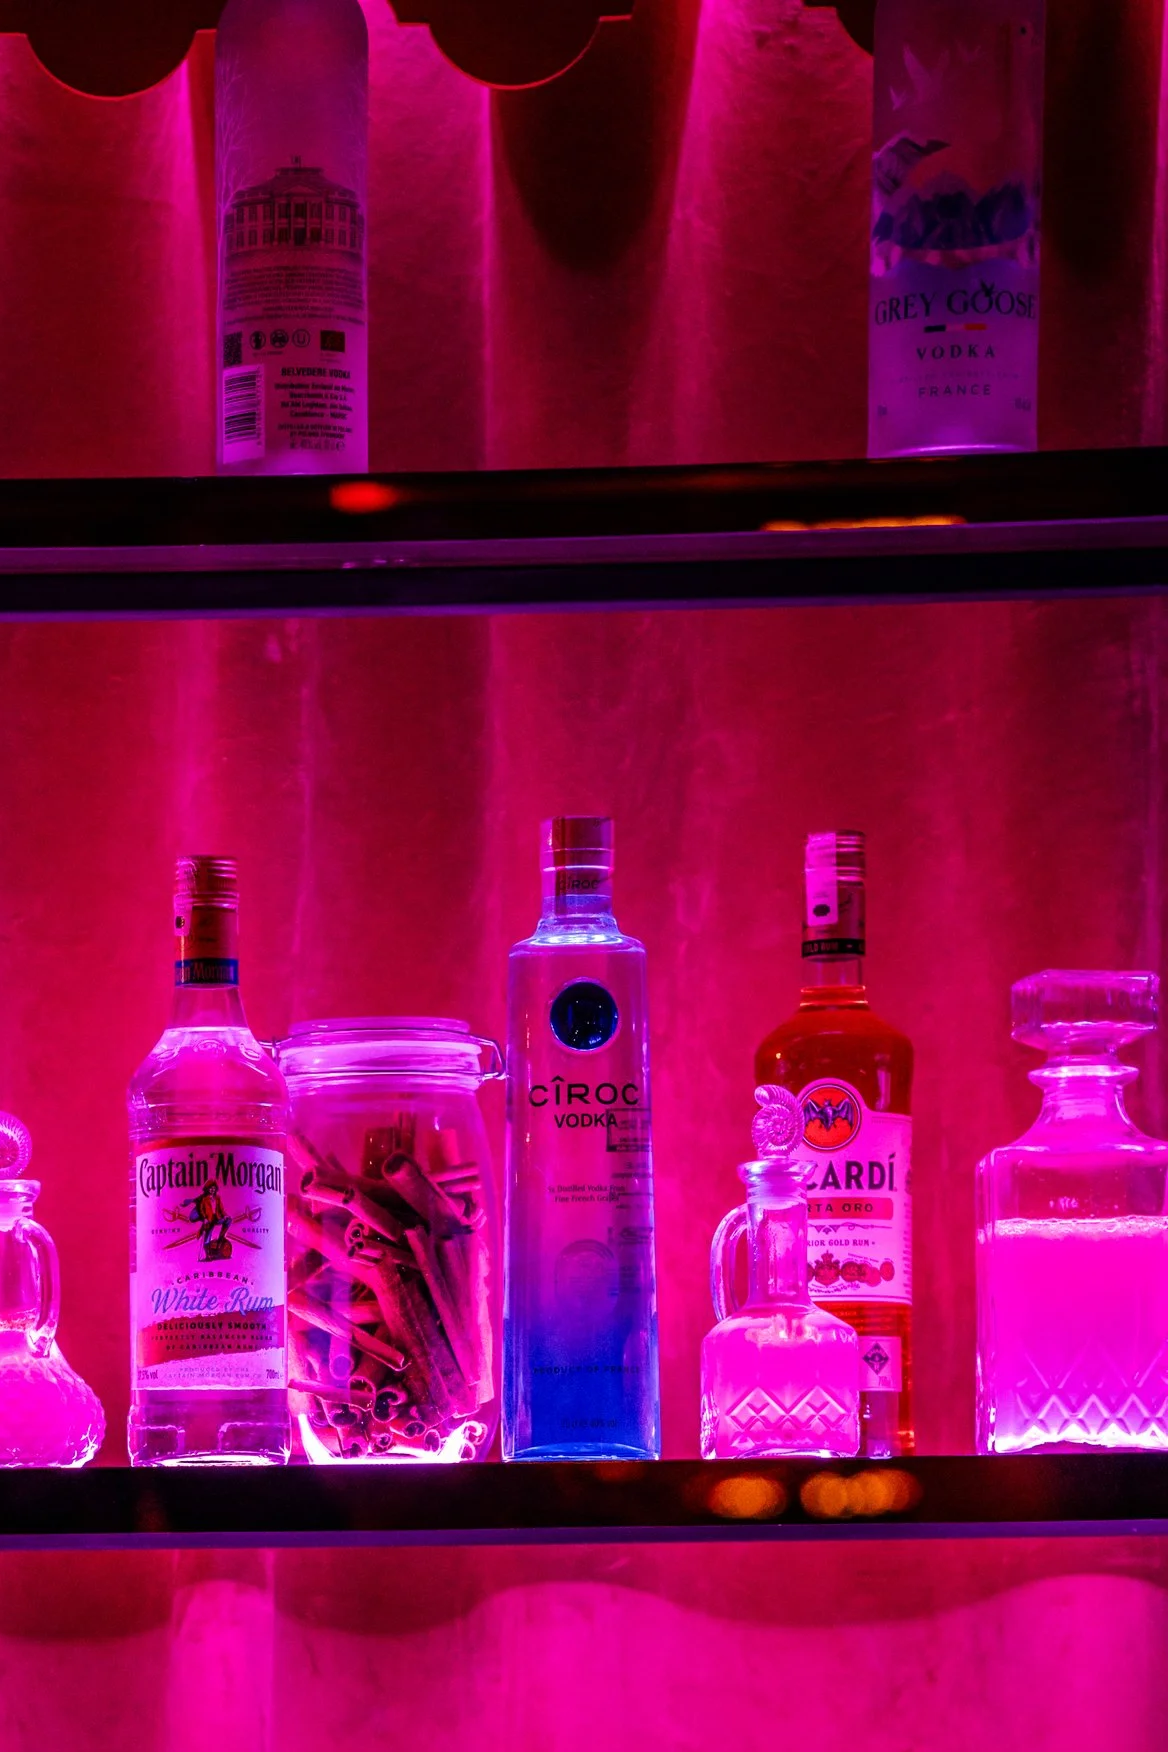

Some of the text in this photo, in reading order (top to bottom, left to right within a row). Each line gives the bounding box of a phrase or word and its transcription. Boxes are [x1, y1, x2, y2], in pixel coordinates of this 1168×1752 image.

[875, 288, 1037, 325] GREY GOOSE
[916, 343, 995, 361] VODKA
[281, 366, 327, 378] BELVEDERE
[918, 384, 992, 398] FRANCE
[529, 1075, 640, 1107] CÎROC
[554, 1112, 618, 1128] VODKA
[139, 1152, 282, 1197] Captain Morgan
[842, 1203, 874, 1212] ORO
[242, 1227, 269, 1235] QUALITY
[828, 1239, 850, 1247] GOLD
[852, 1239, 870, 1247] RUM
[177, 1270, 249, 1285] CARIBBEAN
[151, 1287, 275, 1315] White Rum
[157, 1321, 267, 1331] DELICIOUSLY SMOOTH
